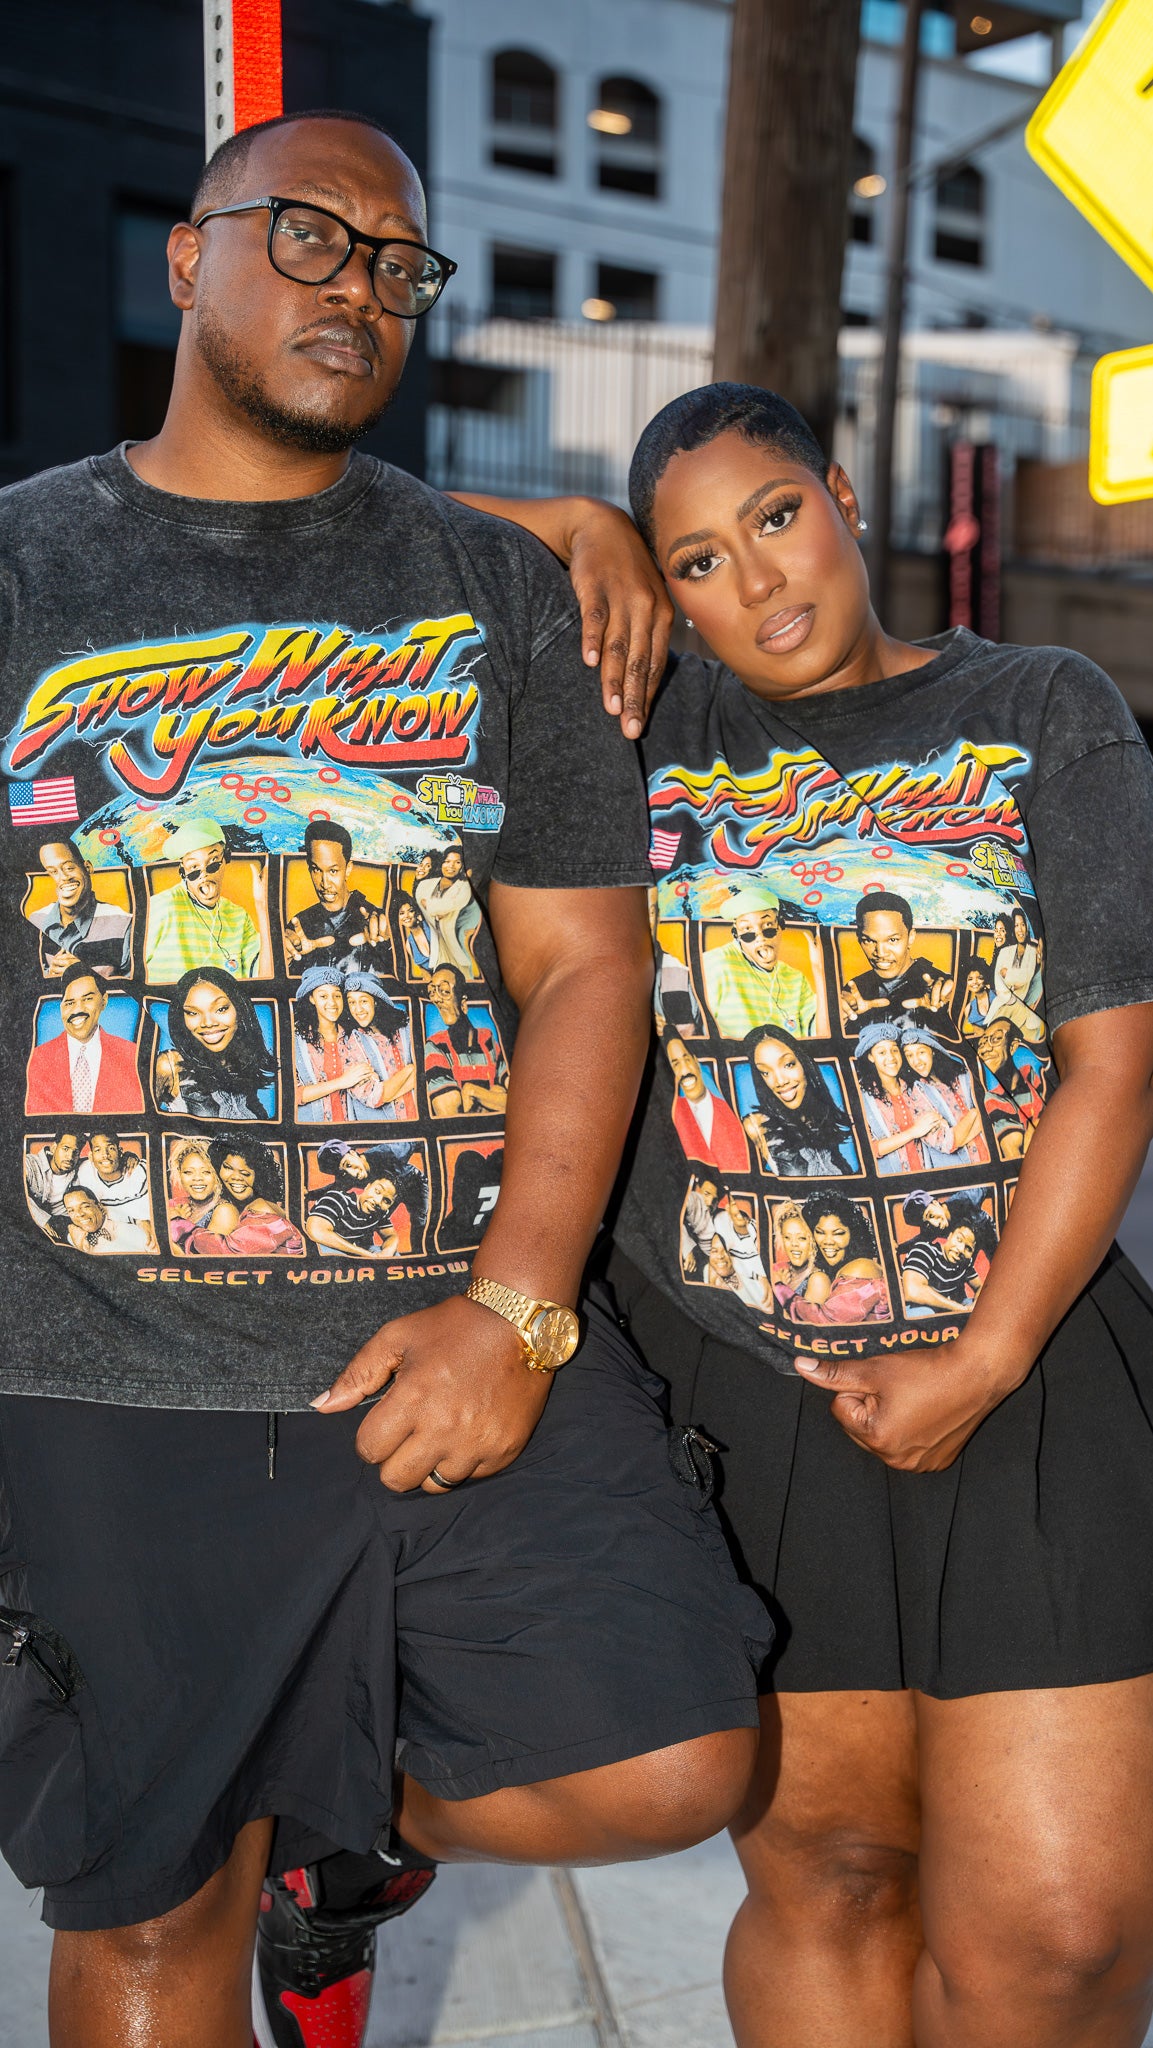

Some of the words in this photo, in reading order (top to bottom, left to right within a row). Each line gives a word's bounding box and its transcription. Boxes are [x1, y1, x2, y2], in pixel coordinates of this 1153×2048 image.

[137, 1268, 273, 1286] SELECT
[287, 1267, 375, 1284] YOUR
[386, 1261, 468, 1281] SHOW
[880, 1326, 960, 1348] YOUR
